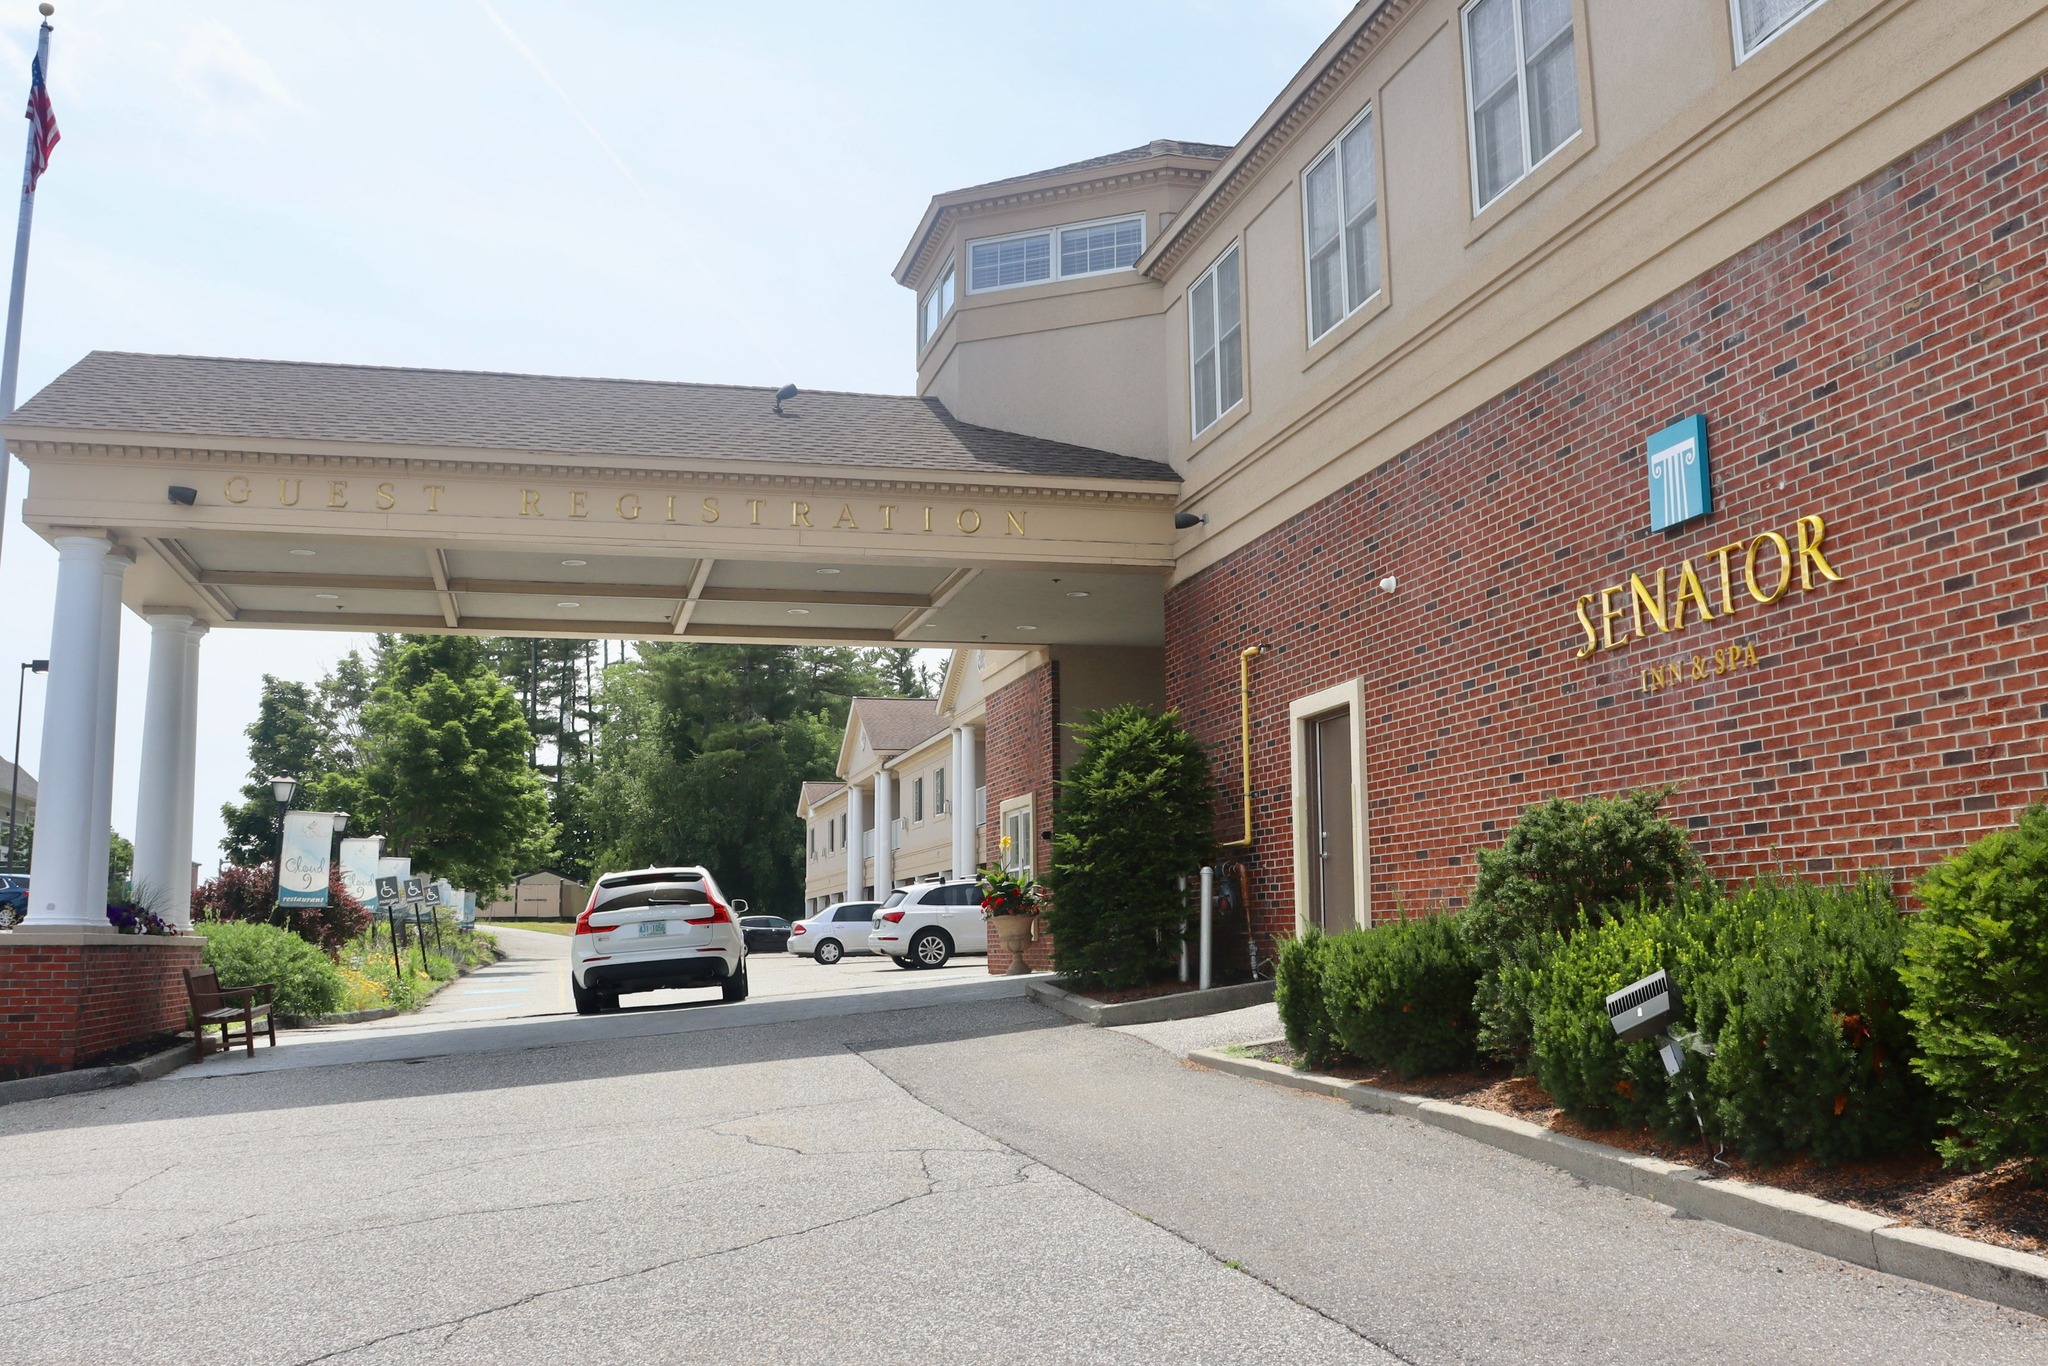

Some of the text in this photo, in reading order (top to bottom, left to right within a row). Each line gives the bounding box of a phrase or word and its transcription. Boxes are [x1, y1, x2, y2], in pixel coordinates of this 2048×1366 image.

[223, 475, 1028, 536] GUEST REGISTRATION
[1576, 514, 1844, 659] SENATOR
[1640, 640, 1759, 693] INN & SPA
[285, 855, 325, 874] Cloud
[302, 873, 312, 890] 9
